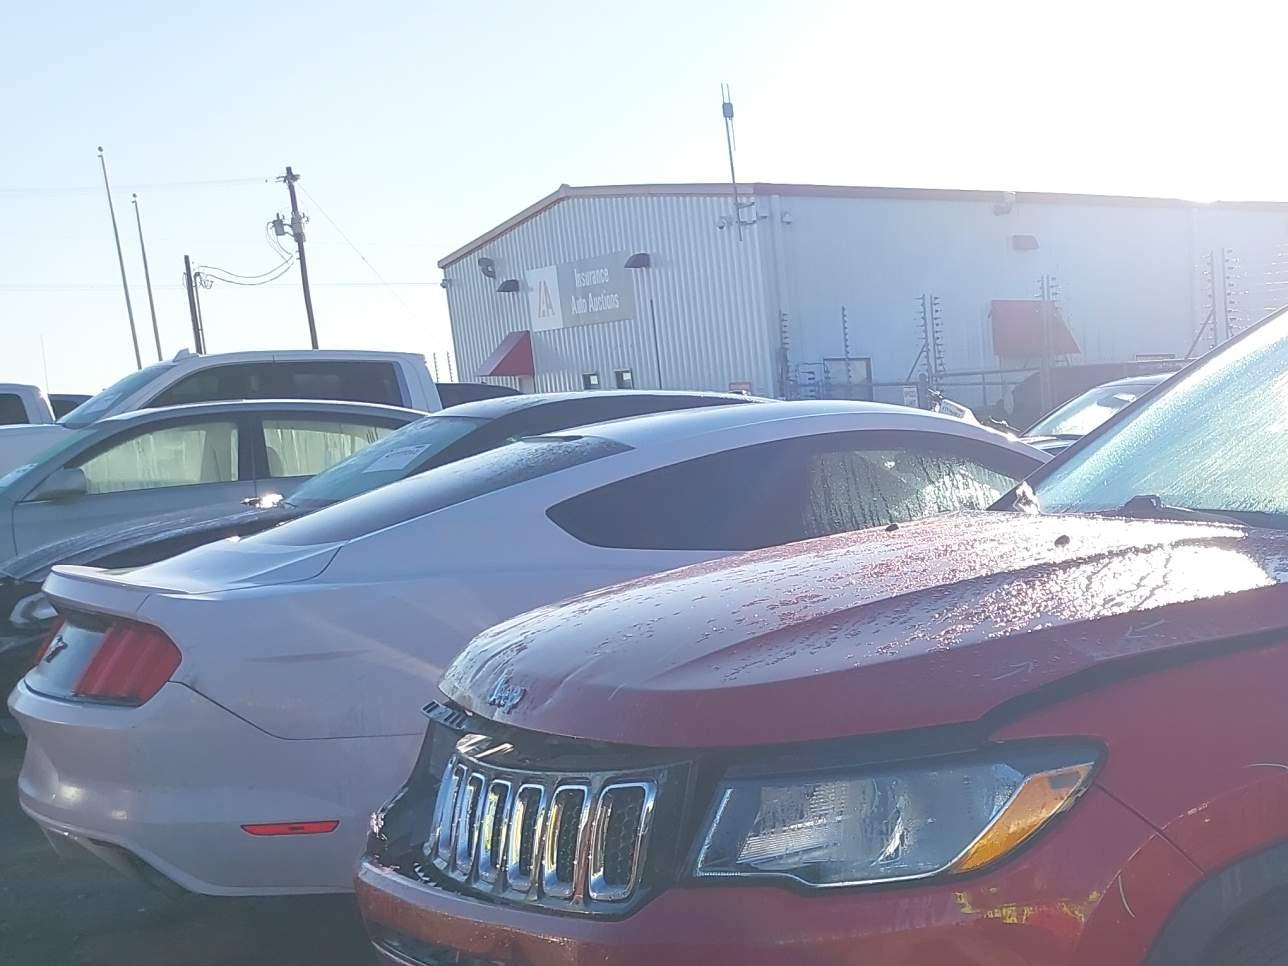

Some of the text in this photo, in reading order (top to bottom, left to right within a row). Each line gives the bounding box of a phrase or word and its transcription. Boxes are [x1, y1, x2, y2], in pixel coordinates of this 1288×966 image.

[574, 268, 609, 288] Insurance
[571, 290, 620, 315] Auto Auctions
